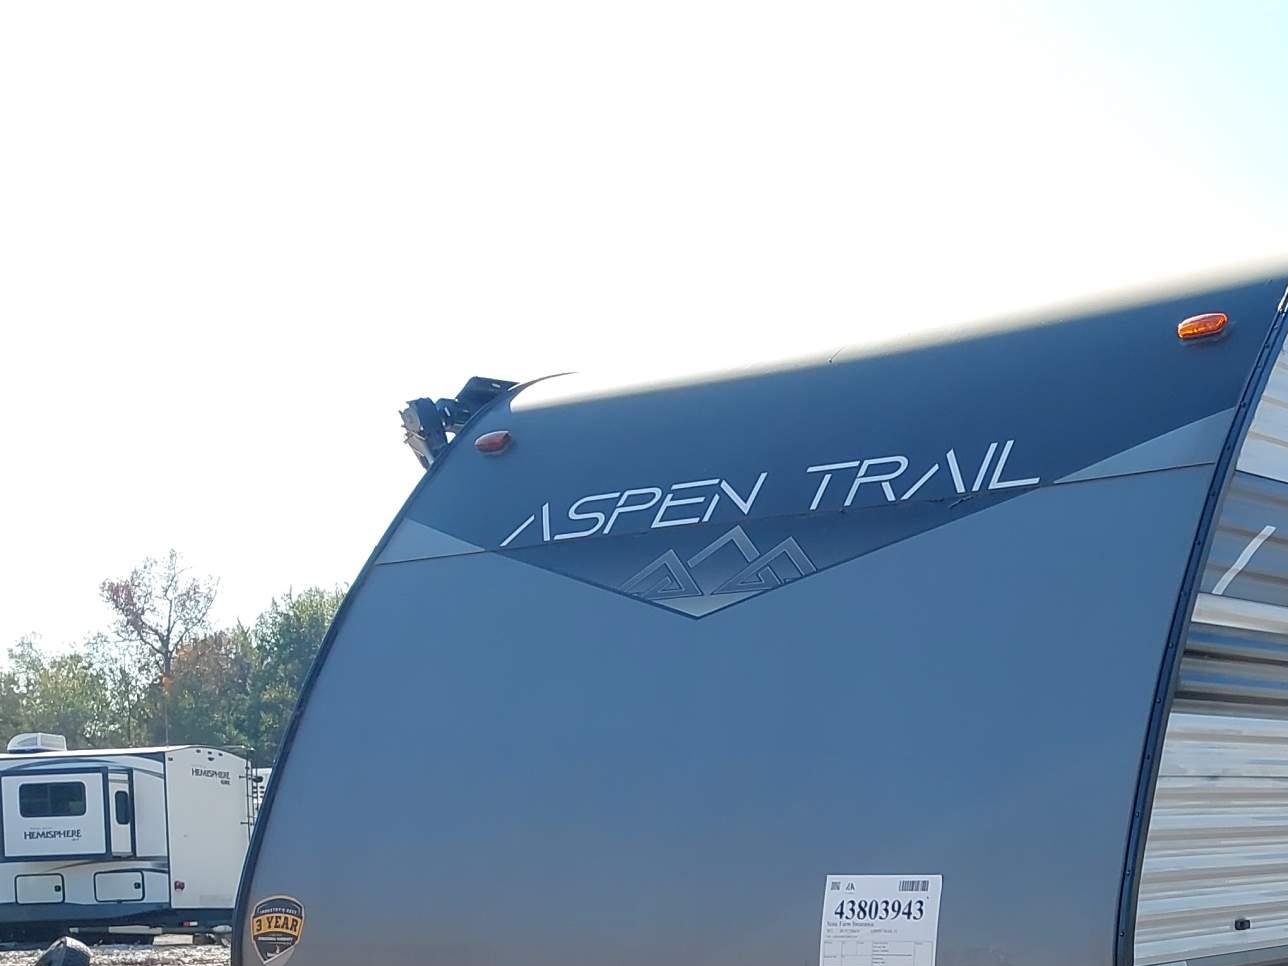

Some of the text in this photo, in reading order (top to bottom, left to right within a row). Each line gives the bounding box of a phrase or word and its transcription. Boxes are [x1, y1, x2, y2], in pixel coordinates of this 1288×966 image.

[500, 440, 1040, 547] ASPEN TRAIL
[834, 899, 924, 920] 43803943
[255, 915, 299, 933] 3 YEAR
